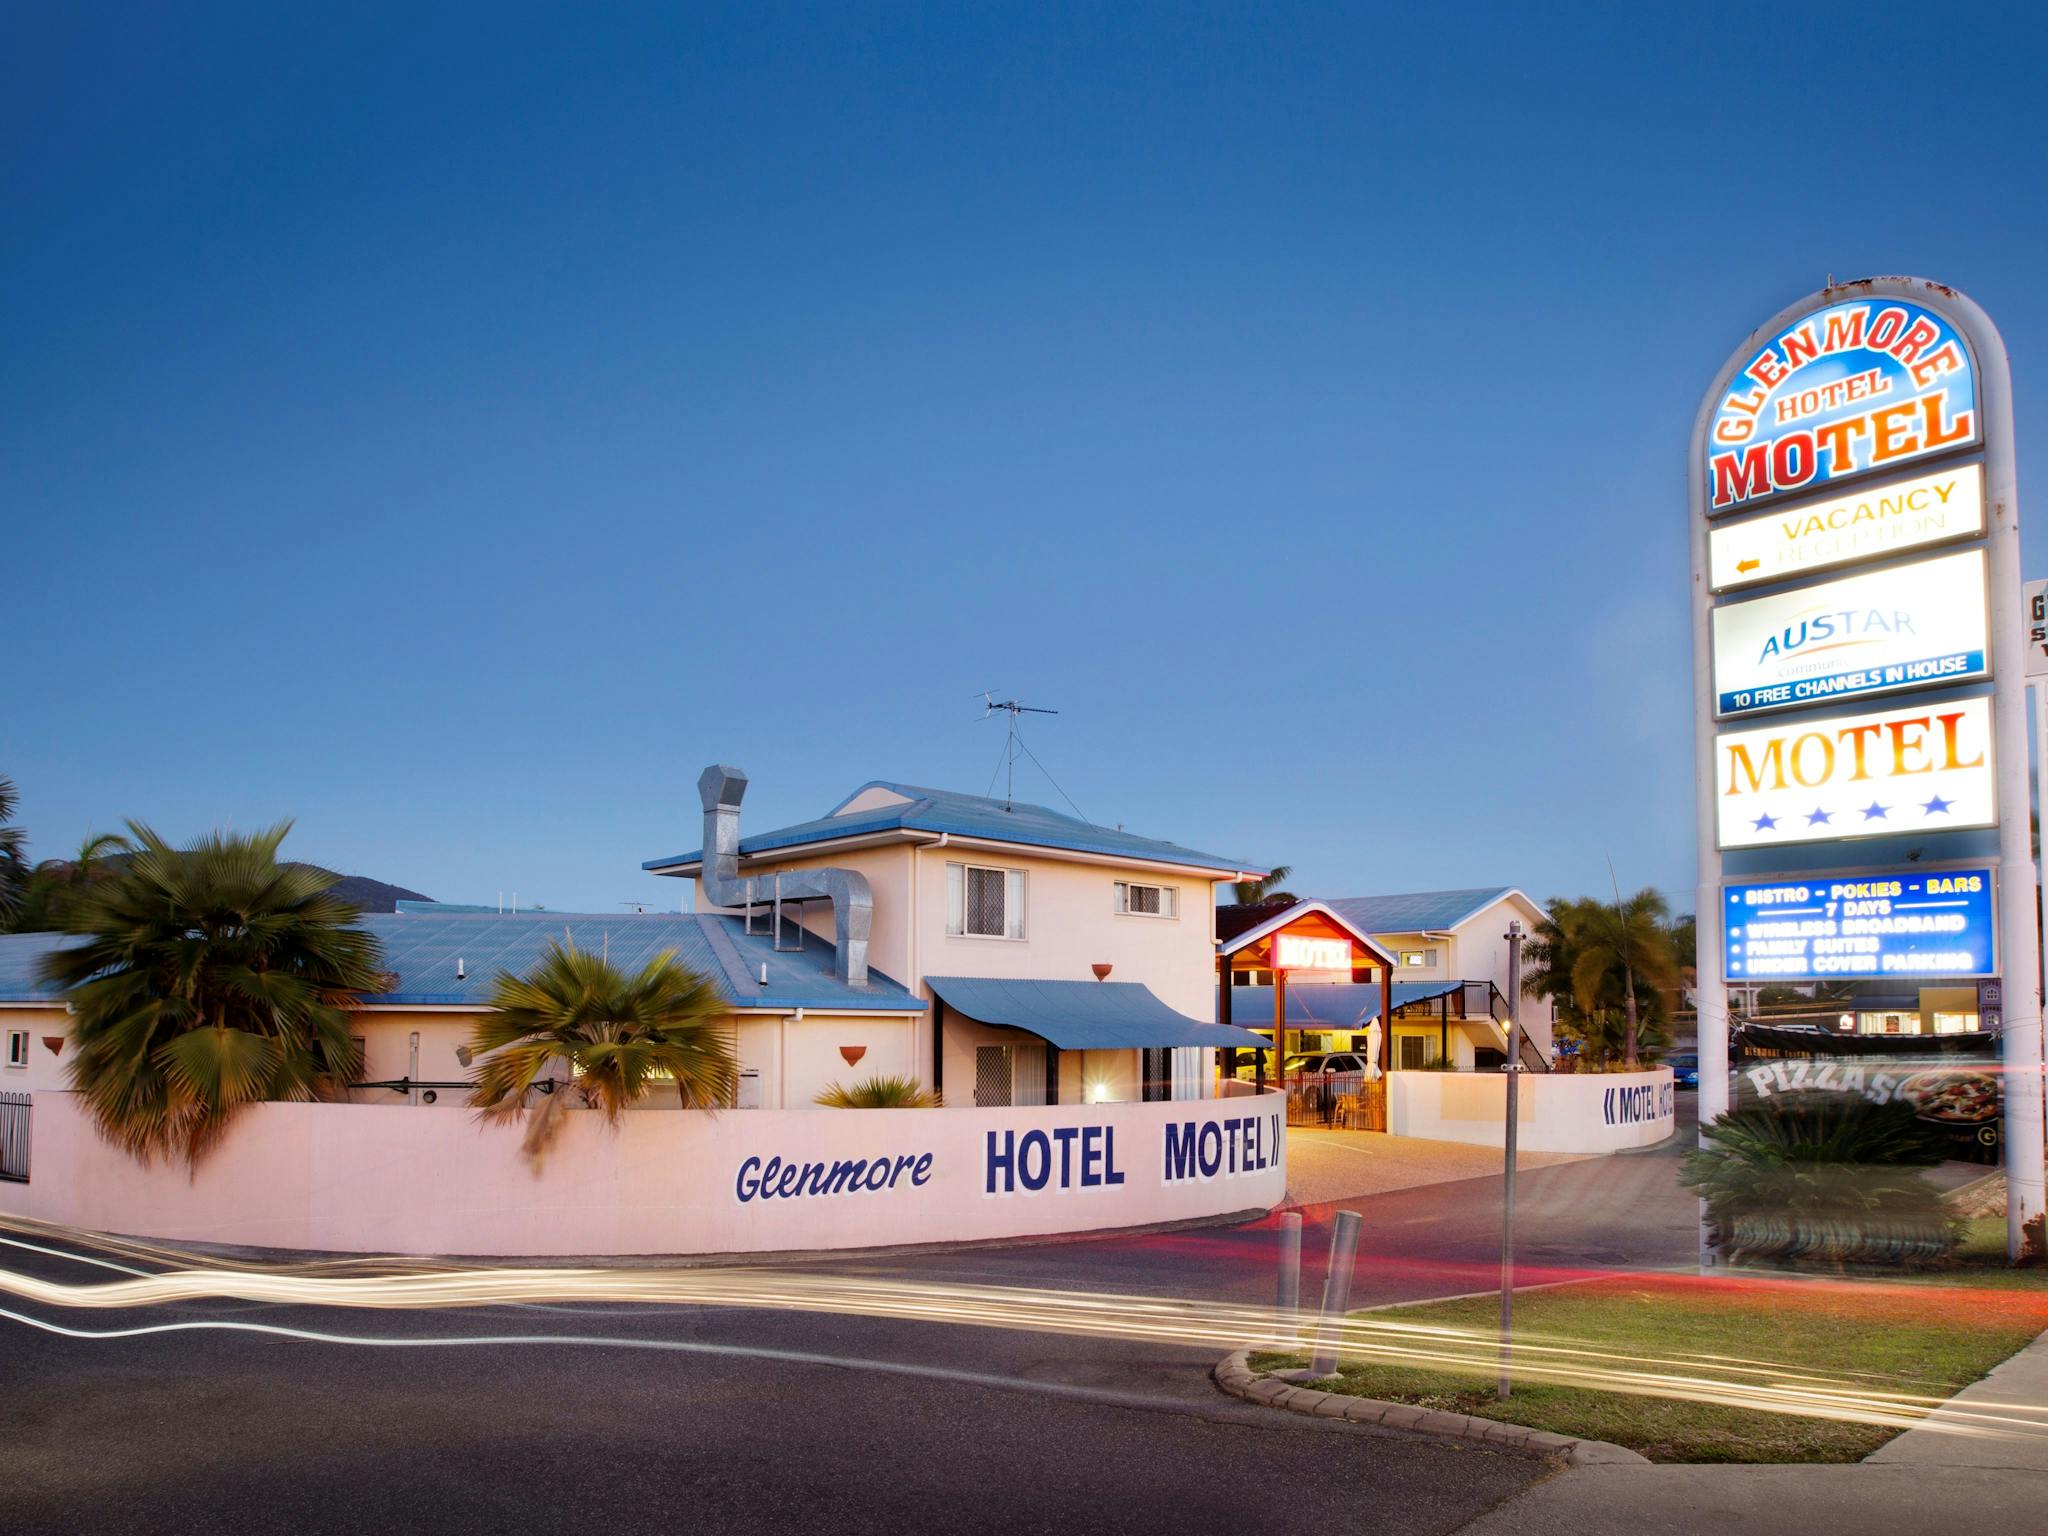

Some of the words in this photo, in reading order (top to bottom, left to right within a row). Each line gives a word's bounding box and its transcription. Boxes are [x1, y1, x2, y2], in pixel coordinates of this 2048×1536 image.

[1714, 307, 1965, 444] GLENMORE
[1776, 368, 1891, 424] HOTEL
[1713, 391, 1973, 507] MOTEL
[1782, 481, 1956, 540] VACANCY
[1759, 609, 1917, 666] AUSTAR
[1733, 693, 1750, 708] 10
[1755, 686, 1791, 704] FREE
[1795, 670, 1881, 698] CHANNELS
[1886, 665, 1904, 683] IN
[1907, 656, 1967, 680] HOUSE
[1724, 712, 1985, 796] MOTEL
[1746, 887, 1809, 905] BISTRO
[1831, 881, 1902, 900] POKIES
[1926, 877, 1982, 894] BARS
[1825, 903, 1836, 917] 7
[1844, 901, 1891, 916] DAYS
[1842, 915, 1966, 935] BROADBAND
[1279, 937, 1351, 968] MOTEL
[1813, 956, 1877, 972] COVER
[1620, 1085, 1655, 1123] MOTEL
[1746, 1060, 1896, 1106] PIZZAS
[735, 1152, 933, 1203] Glenmore
[985, 1126, 1125, 1194] HOTEL
[1164, 1117, 1267, 1181] MOTEL
